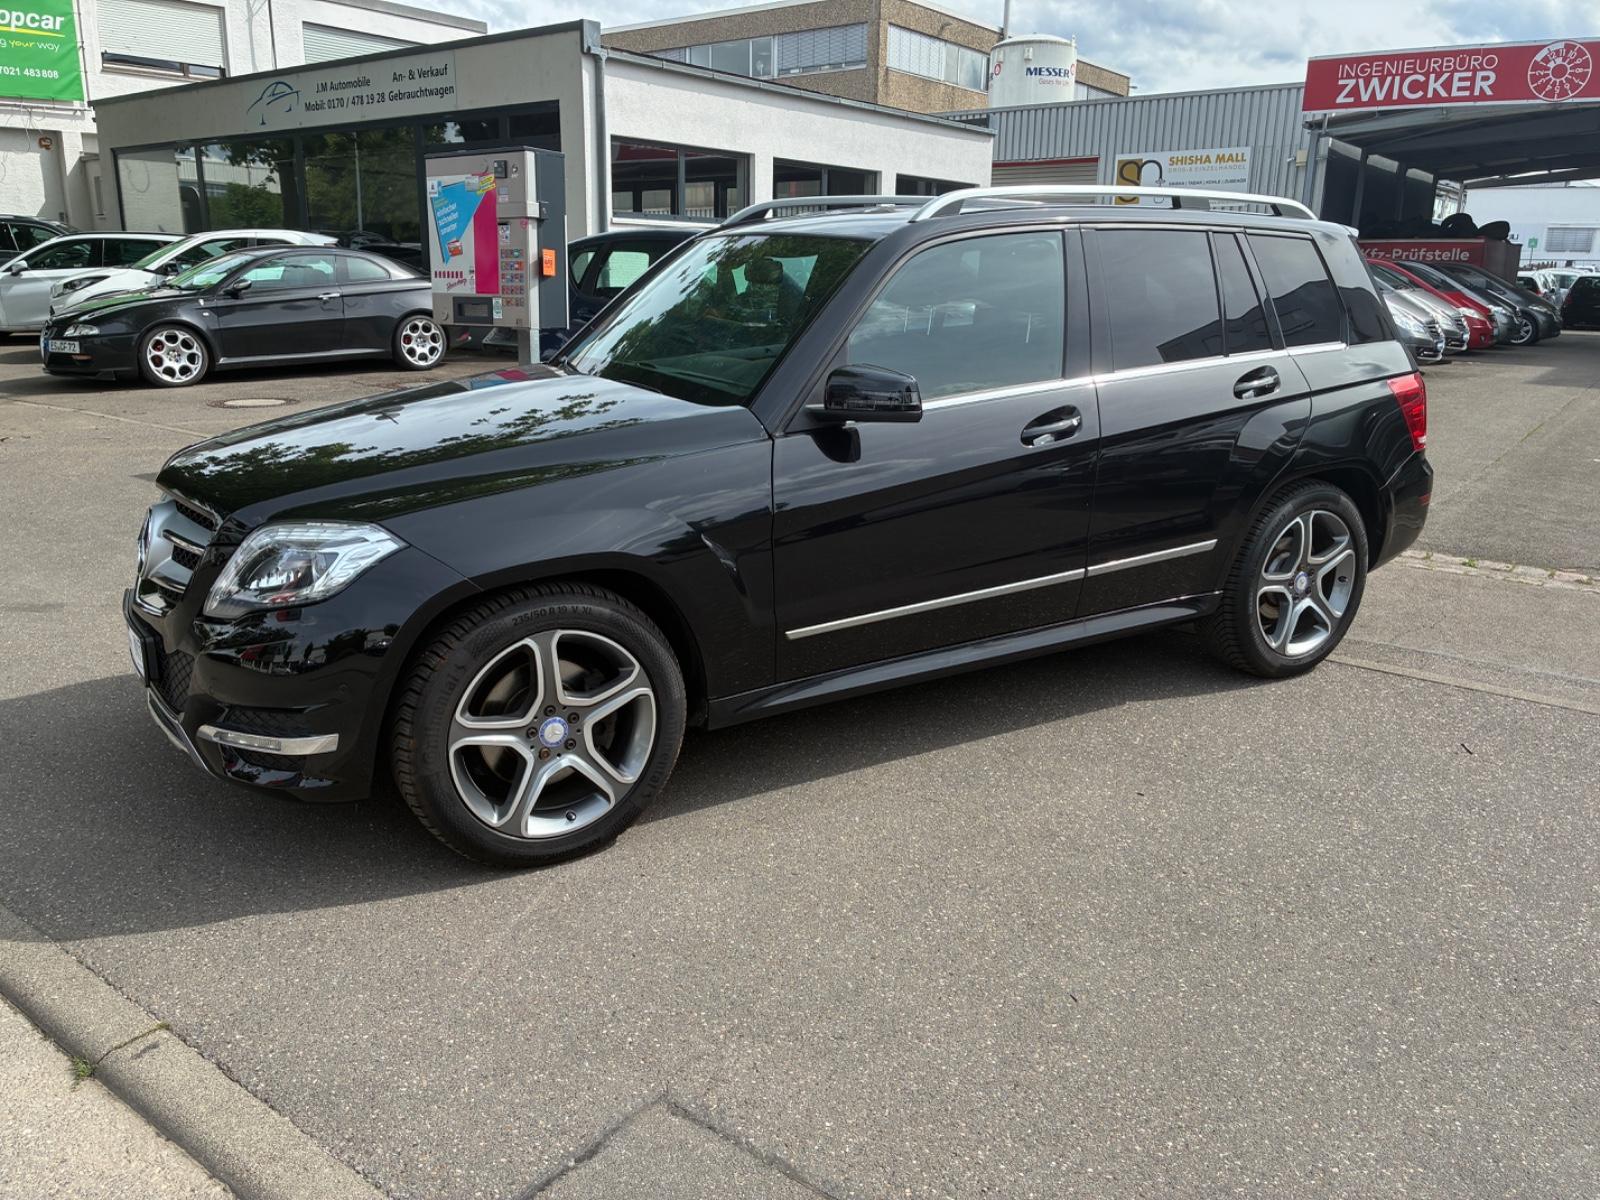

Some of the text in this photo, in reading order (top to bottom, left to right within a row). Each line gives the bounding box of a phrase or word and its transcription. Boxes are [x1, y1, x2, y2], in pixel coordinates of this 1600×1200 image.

[9, 39, 35, 48] your
[37, 42, 60, 52] way
[392, 63, 448, 82] An- & Verkauf
[1025, 66, 1070, 78] MESSER
[1338, 54, 1499, 79] INGENIEURBÜRO
[329, 75, 371, 91] Automobile
[1335, 70, 1497, 104] ZWICKER
[304, 99, 326, 112] Mobil:
[327, 97, 345, 109] 0170
[366, 93, 375, 105] 19
[376, 92, 386, 103] 28
[388, 85, 455, 102] Gebrauchtwagen
[1168, 151, 1247, 166] SHISHA MALL
[1360, 247, 1470, 261] Kfz-Prüfstelle
[511, 607, 547, 626] 235/50
[548, 606, 556, 616] R
[571, 605, 578, 614] V
